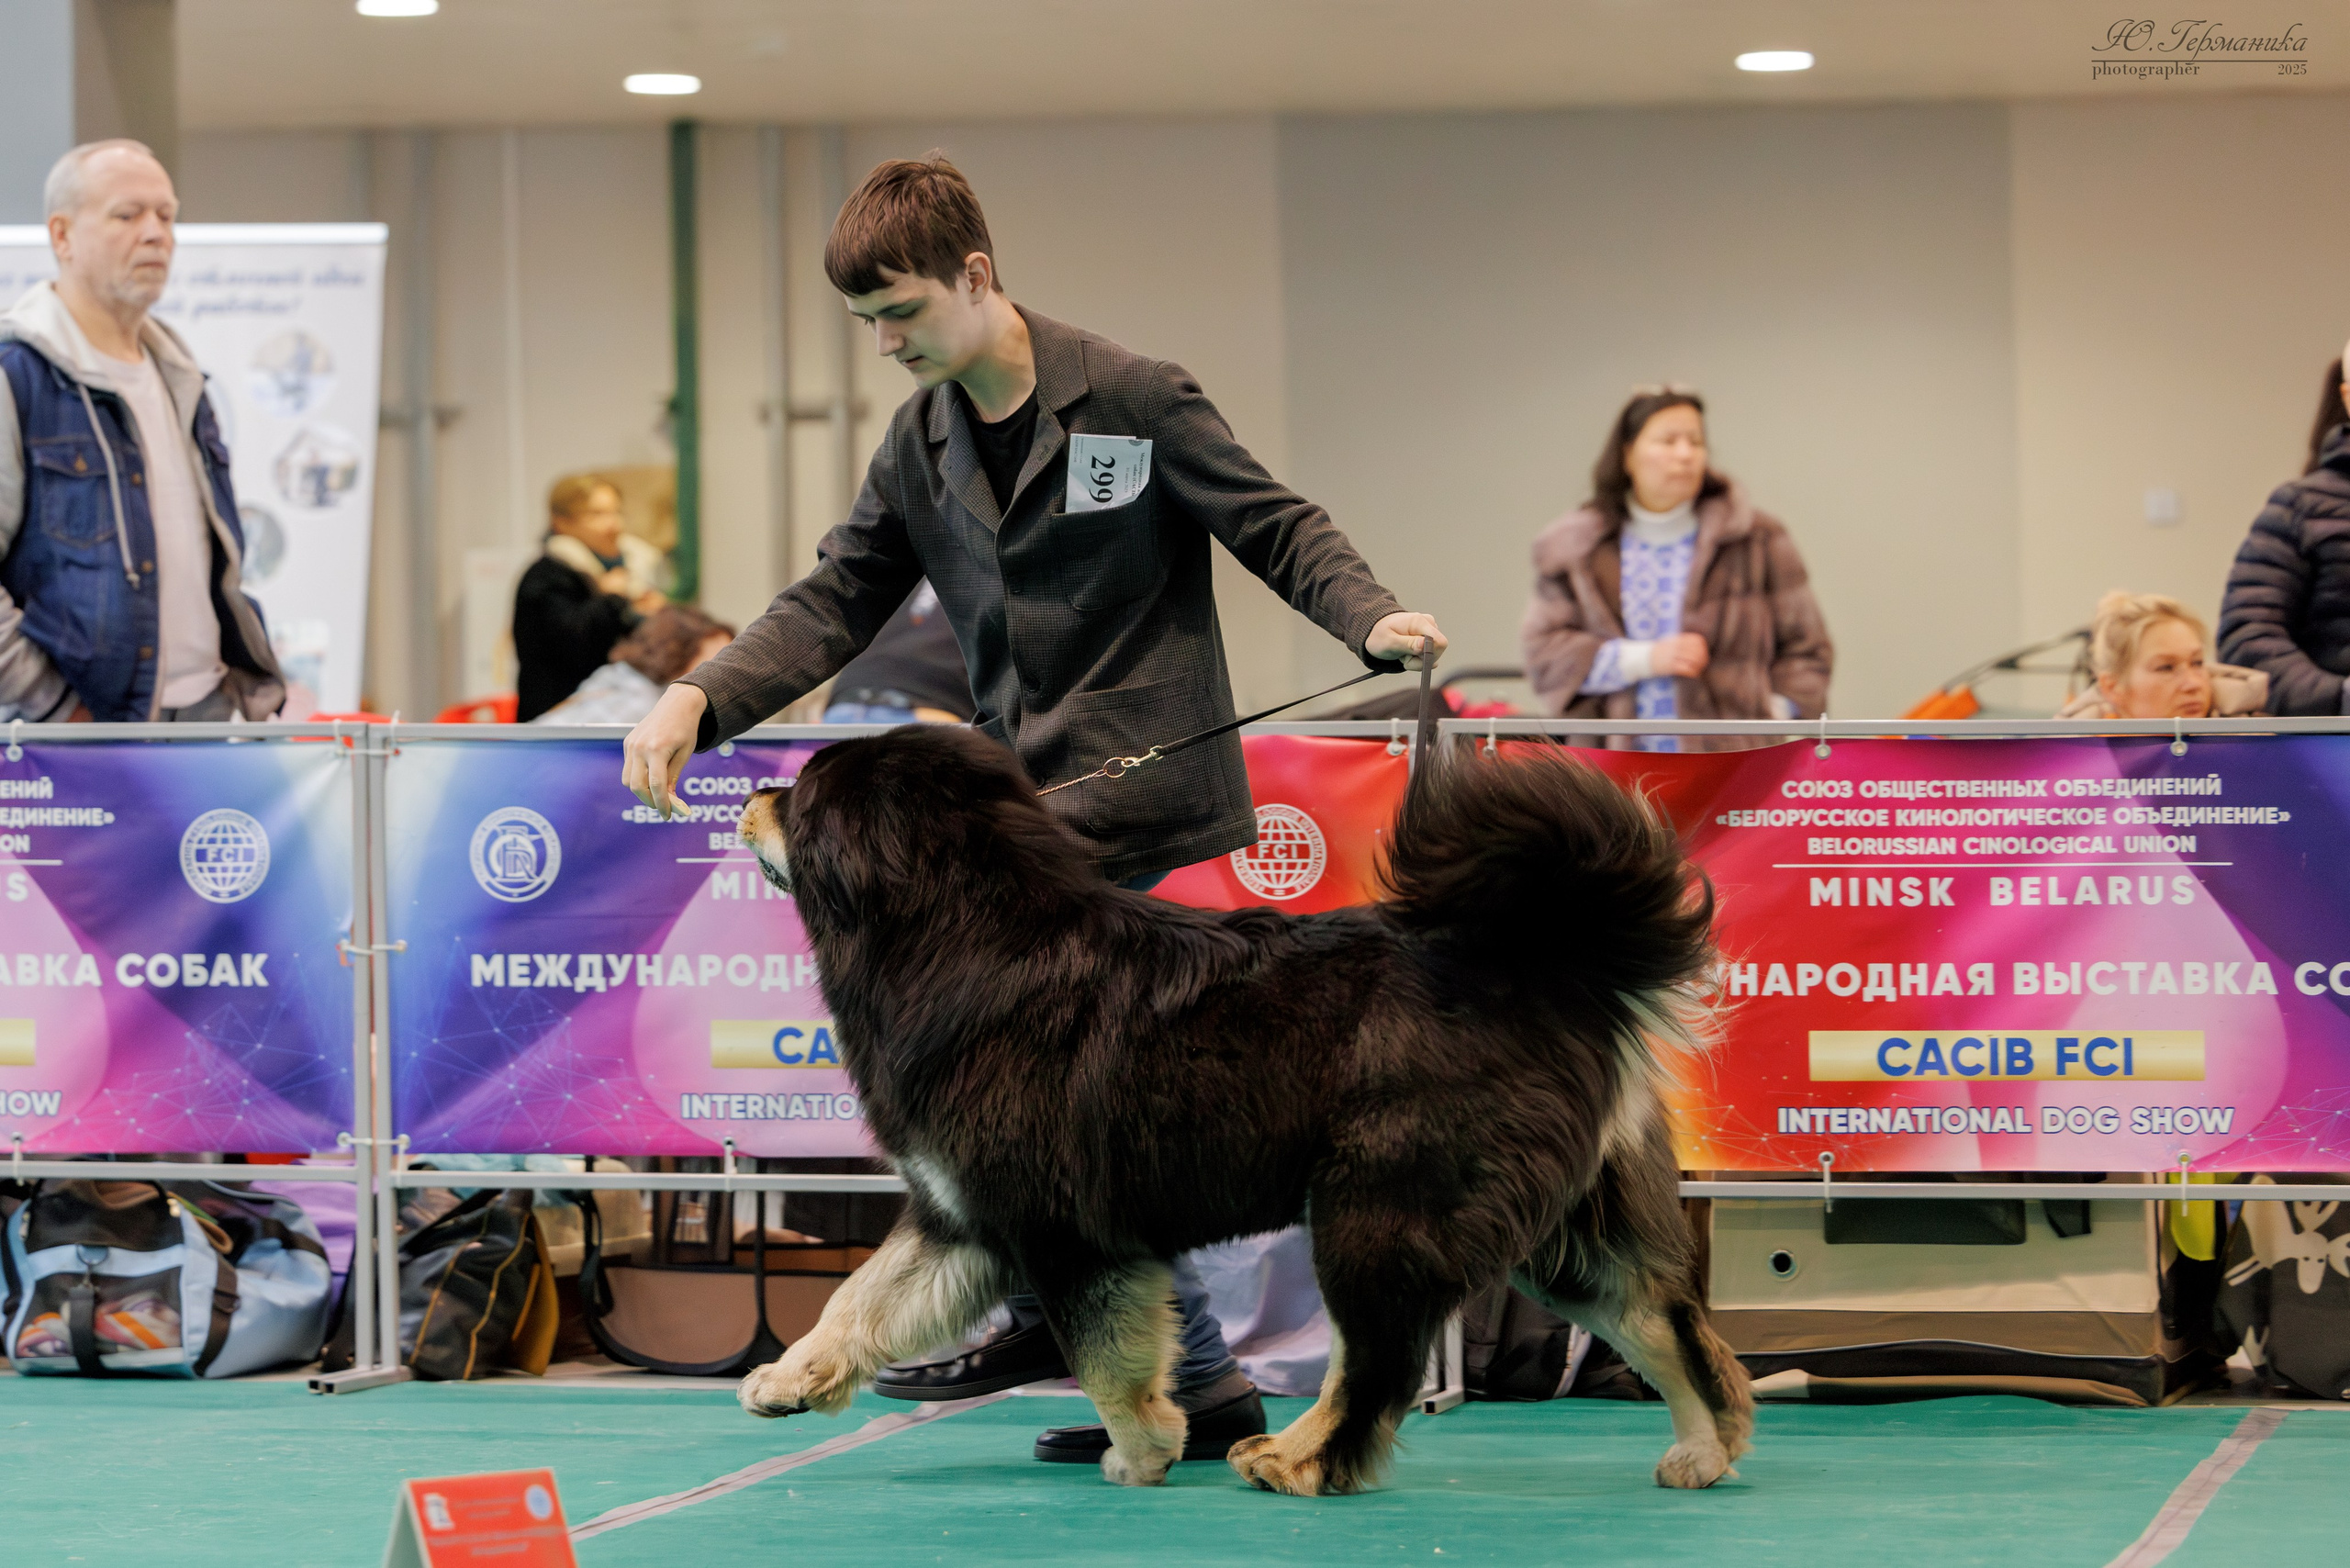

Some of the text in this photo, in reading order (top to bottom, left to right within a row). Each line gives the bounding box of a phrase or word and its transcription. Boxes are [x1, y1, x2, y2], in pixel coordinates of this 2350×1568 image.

[1089, 455, 1115, 504] 299
[684, 777, 752, 795] СОЮЗ
[1781, 773, 2221, 801] СОЮЗ ОБЩЕСТВЕННЫХ ОБЪЕДИНЕНИЙ
[1716, 807, 2291, 827] «БЕЛОРУССКОЕ КИНОЛОГИЧЕСКОЕ ОБЪЕДИНЕНИЕ»
[207, 847, 243, 863] FCI
[1258, 844, 1298, 859] FCI
[1807, 835, 2197, 855] BELORUSSIAN CINOLOGICAL UNION
[1809, 875, 2196, 907] MINSK BELARUS
[115, 952, 269, 987] СОБАК
[2013, 961, 2279, 995] ВЫСТАВКА
[1876, 1037, 2133, 1076] CACIB FCI
[681, 1093, 863, 1119] INTERNATIO
[1778, 1106, 2235, 1134] INTERNATIONAL DOG SHOW
